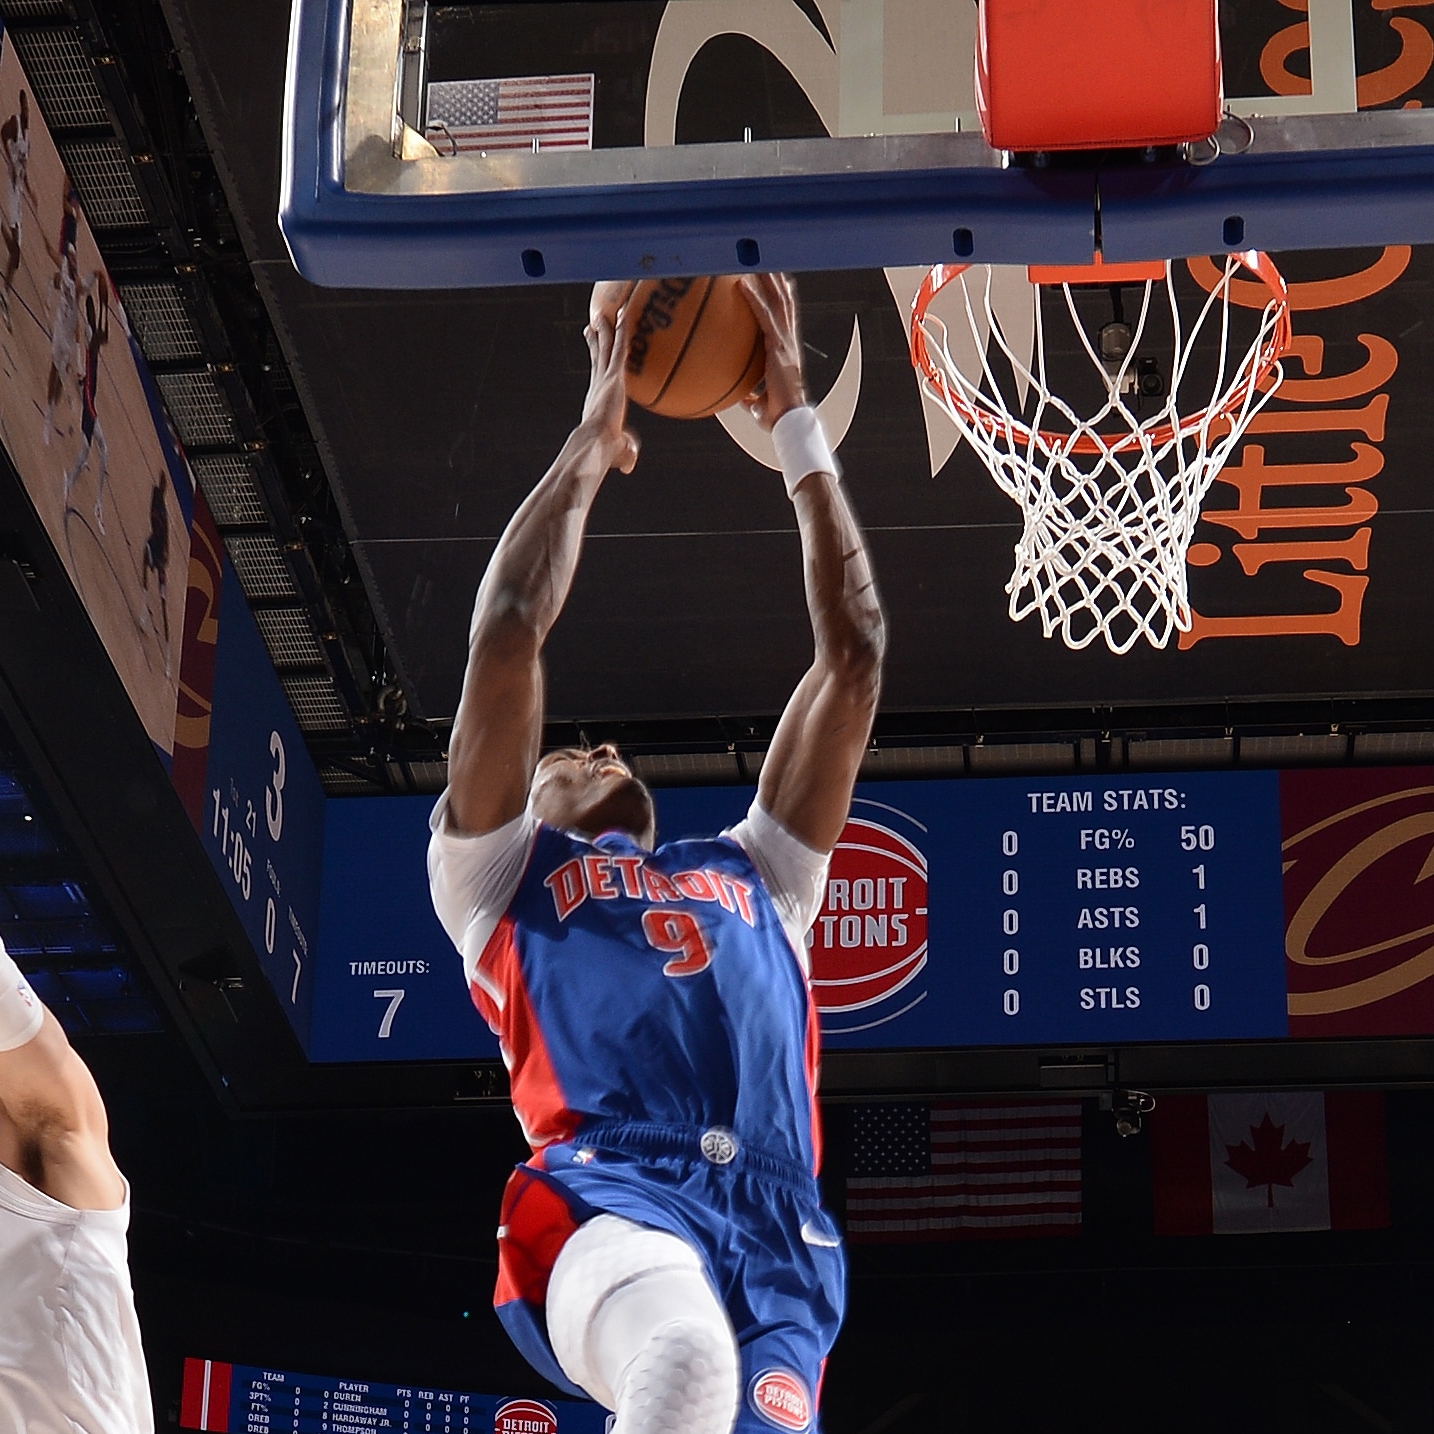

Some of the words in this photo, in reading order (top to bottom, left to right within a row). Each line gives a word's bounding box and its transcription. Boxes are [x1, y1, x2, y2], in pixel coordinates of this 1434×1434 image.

[1177, 332, 1400, 651] Little
[266, 730, 286, 841] 3
[1027, 791, 1093, 813] TEAM
[1103, 788, 1187, 811] STATS:
[212, 787, 252, 901] 11:05
[1002, 831, 1019, 856] 0
[1079, 828, 1136, 850] FG%
[1180, 825, 1215, 851] 50
[543, 853, 756, 929] DETROIT
[1002, 869, 1019, 895] 0
[1076, 868, 1140, 890] REBS
[1192, 864, 1206, 890] 1
[1002, 909, 1019, 935] 0
[1077, 907, 1140, 930] ASTS
[1193, 904, 1207, 930] 1
[640, 907, 714, 977] 9
[349, 959, 431, 976] TIMEOUTS:
[1003, 949, 1019, 975] 0
[1079, 947, 1141, 969] BLKS
[1193, 943, 1209, 970] 0
[373, 989, 406, 1039] 7
[1003, 989, 1020, 1016] 0
[1080, 987, 1141, 1010] STLS
[1194, 983, 1211, 1011] 0
[339, 1381, 369, 1393] PLAYER
[332, 1413, 377, 1426] HARDAWAY
[502, 1418, 549, 1433] DETROIT
